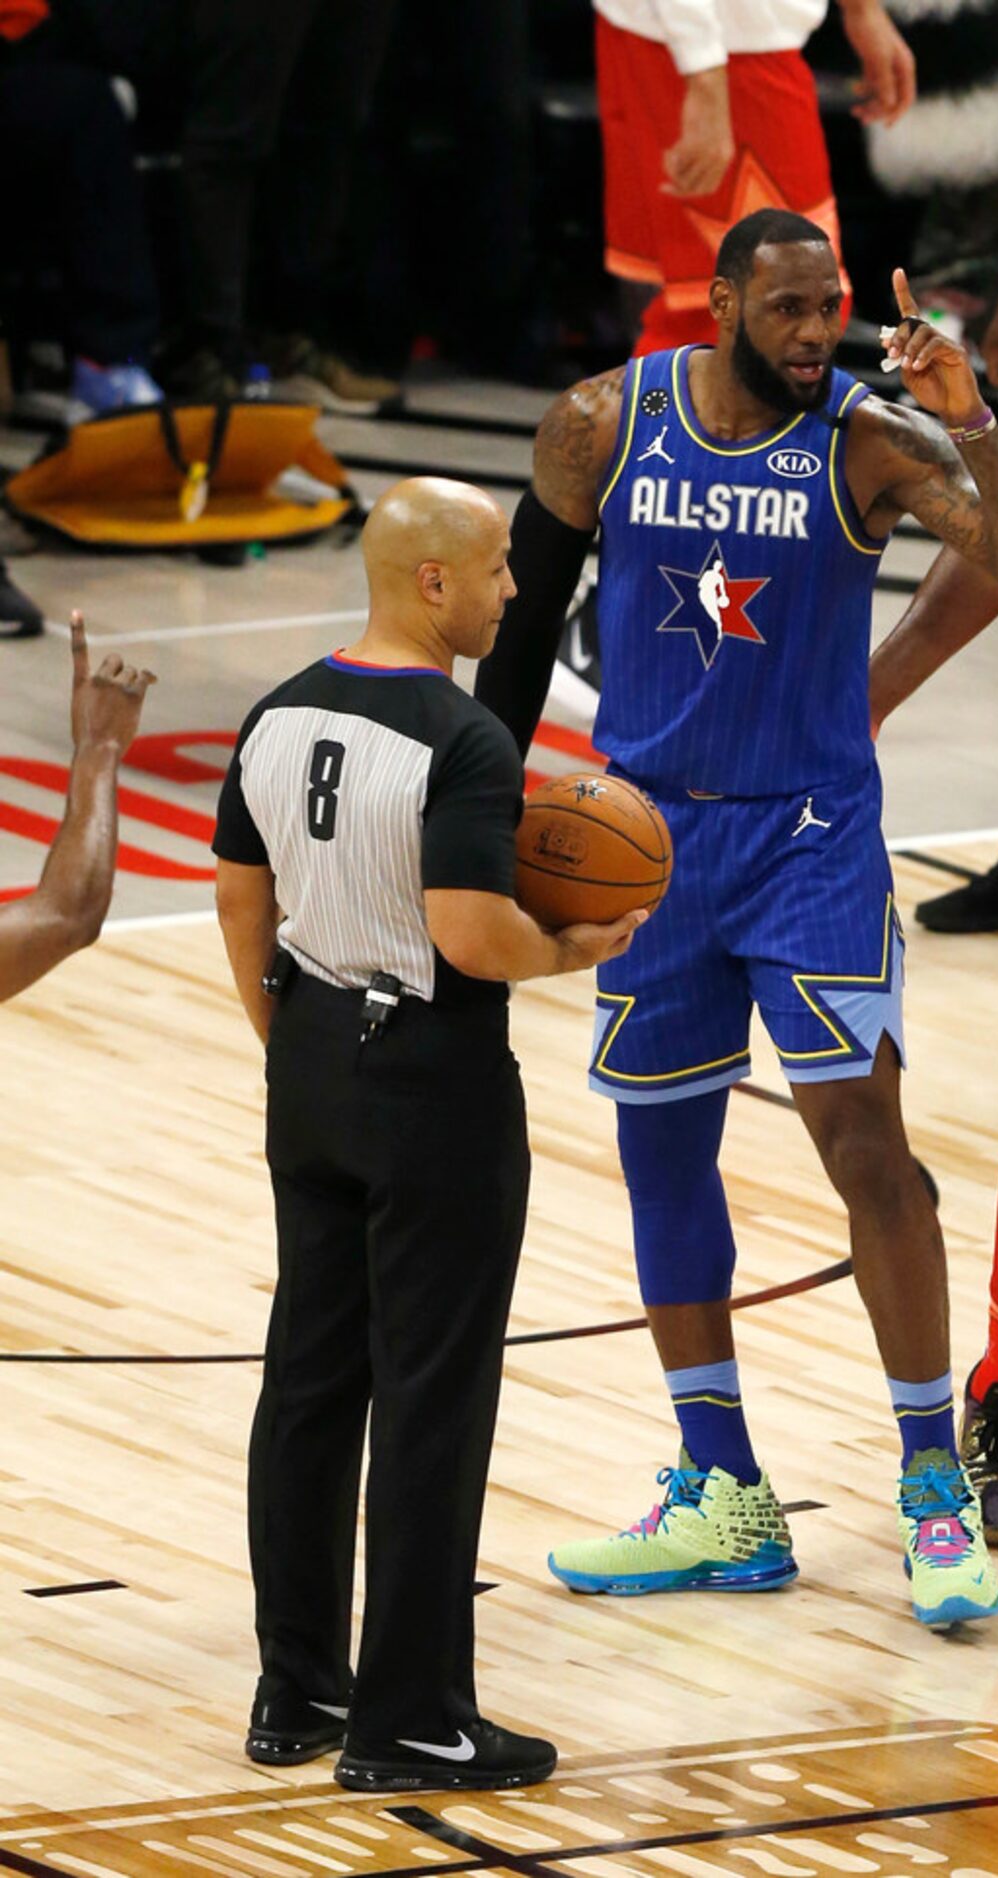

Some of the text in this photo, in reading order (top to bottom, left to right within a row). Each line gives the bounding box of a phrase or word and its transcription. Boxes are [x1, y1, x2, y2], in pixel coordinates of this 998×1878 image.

[775, 453, 813, 473] KIA
[629, 476, 810, 540] ALL-STAR
[307, 739, 346, 842] 8
